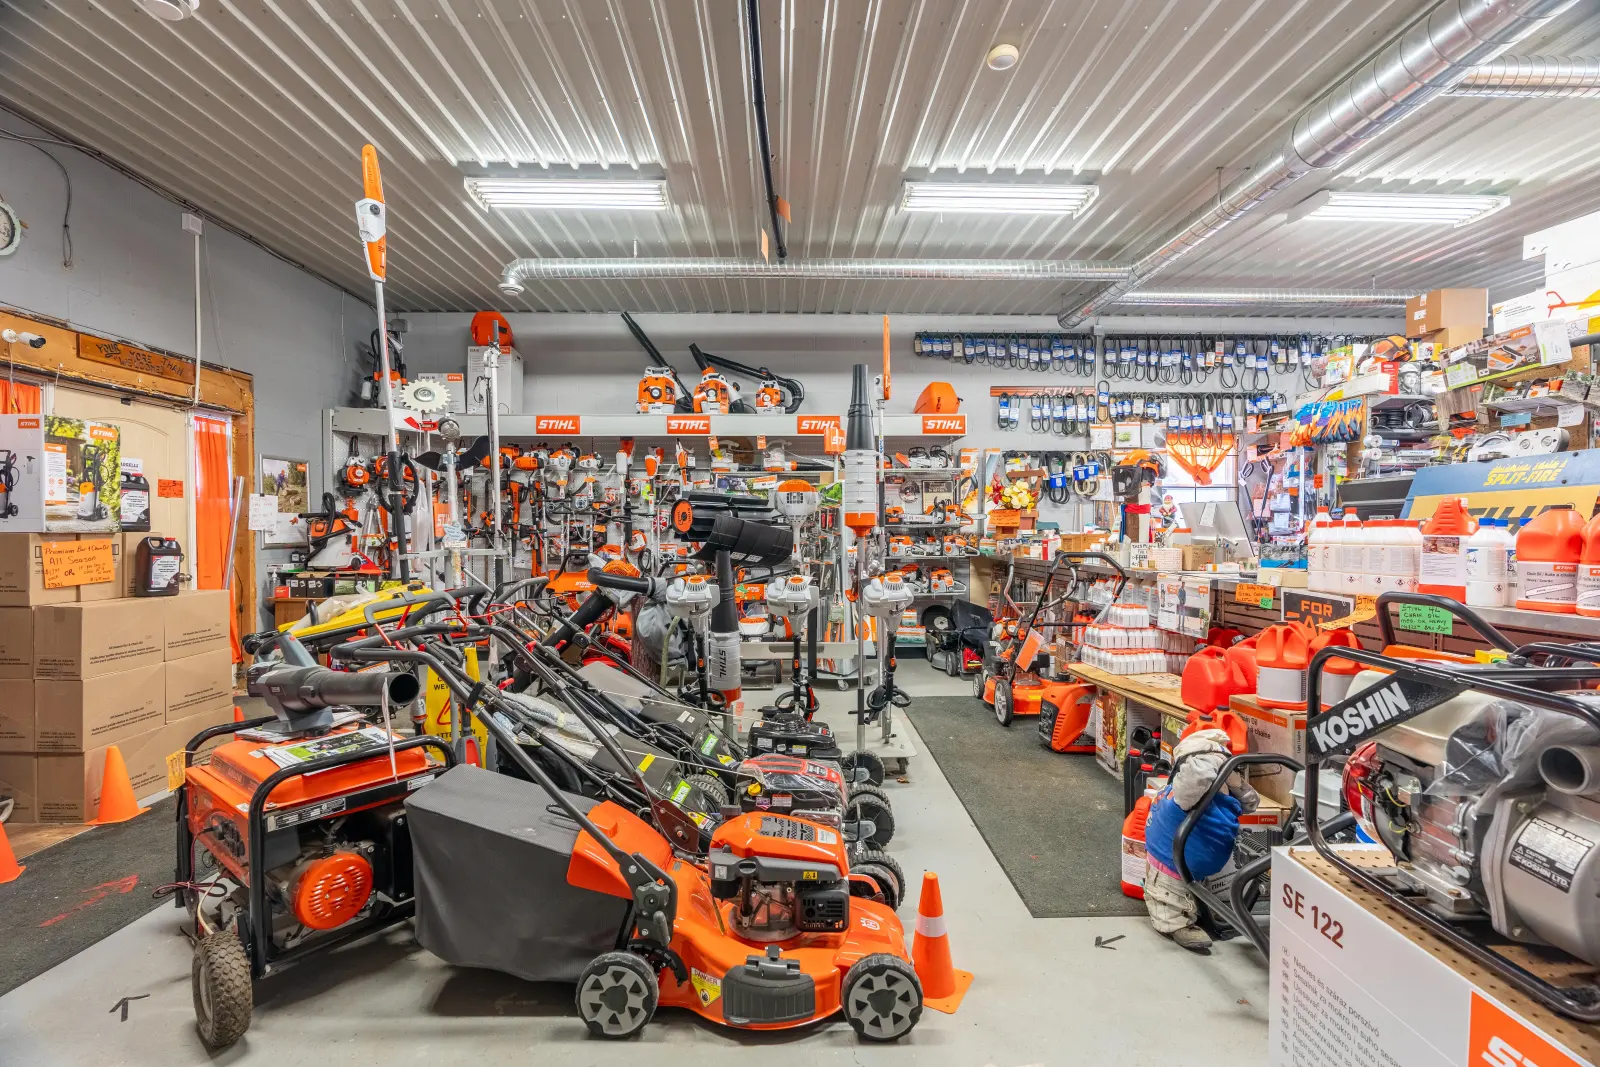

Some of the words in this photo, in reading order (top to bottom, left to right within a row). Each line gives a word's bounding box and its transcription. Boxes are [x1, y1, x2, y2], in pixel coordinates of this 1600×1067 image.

[1044, 387, 1076, 396] STIHL
[538, 419, 576, 430] STIHL
[669, 420, 708, 430] STIHL
[801, 420, 838, 430] STIHL
[925, 420, 963, 430] STIHL
[92, 429, 115, 438] STIHL
[1483, 468, 1563, 487] SPLIT-FIRE
[67, 556, 97, 565] Season
[1301, 600, 1333, 617] FOR
[718, 649, 727, 678] STIHL
[1312, 681, 1411, 753] KOSHIN
[1564, 831, 1594, 847] PUMP
[1525, 849, 1547, 862] CAUTION
[1521, 858, 1552, 878] KOSHIN
[1551, 873, 1569, 888] LTD.
[1282, 883, 1305, 920] SE
[1311, 905, 1344, 950] 122
[695, 969, 718, 986] DANGER
[1293, 956, 1316, 982] Nedves
[1317, 977, 1325, 990] és
[1326, 986, 1348, 1010] száraz
[1349, 1006, 1380, 1037] porszívó
[1293, 968, 1318, 997] Sesalnik
[1319, 993, 1327, 1005] za
[1328, 1001, 1350, 1026] mokro
[1351, 1020, 1359, 1034] in
[1360, 1030, 1379, 1051] suho
[1318, 1019, 1326, 1031] za
[1327, 1027, 1350, 1053] mokro
[1320, 1008, 1329, 1020] za
[1329, 1016, 1352, 1041] mokro
[1357, 1041, 1376, 1063] suho
